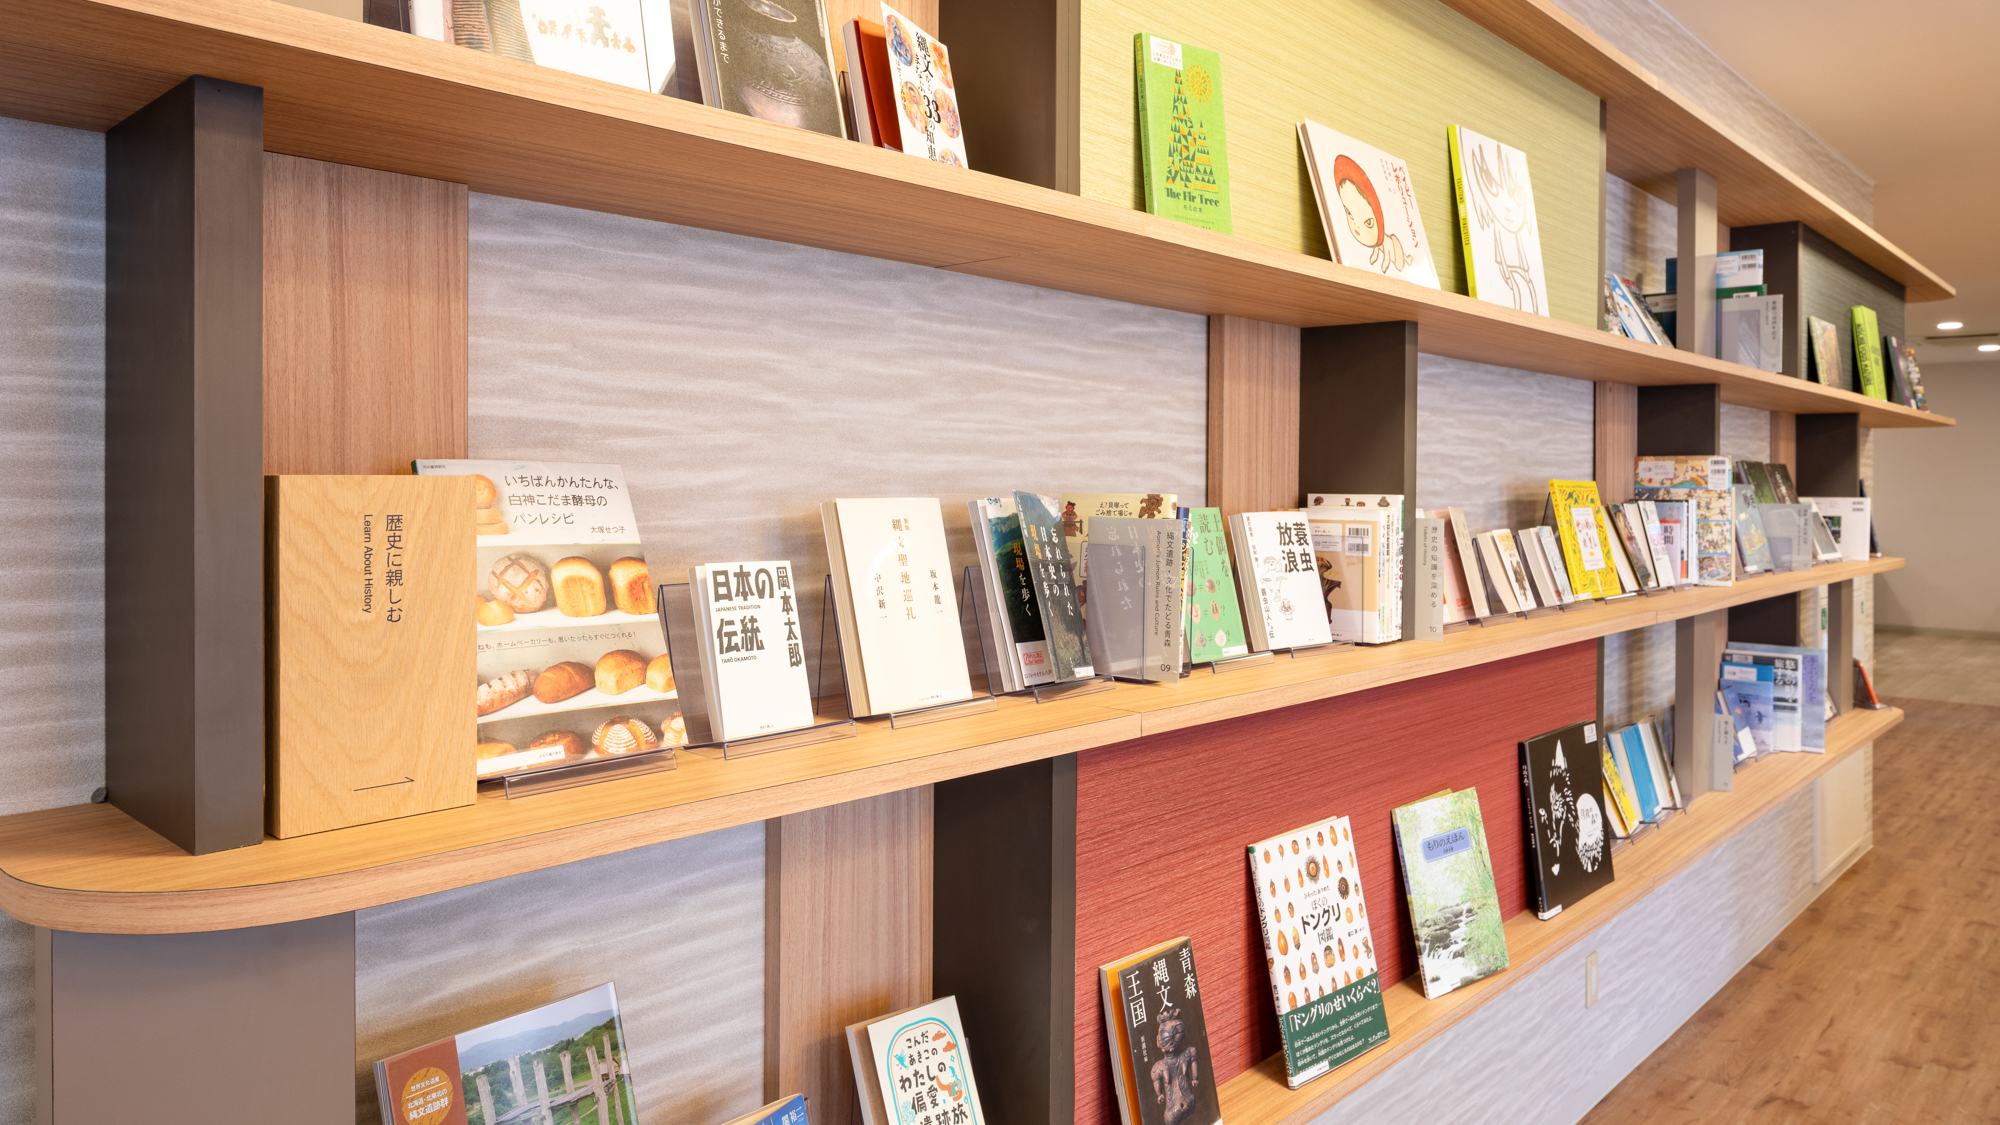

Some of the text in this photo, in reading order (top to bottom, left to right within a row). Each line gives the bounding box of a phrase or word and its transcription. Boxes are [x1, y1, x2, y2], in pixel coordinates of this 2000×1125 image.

[1164, 187, 1220, 207] The Fir Tree
[504, 475, 619, 490] いちばんかんたんな、
[508, 493, 608, 507] 白神こだま酵母の
[513, 512, 575, 525] パンレシピ
[1197, 514, 1214, 556] 読む
[1040, 526, 1060, 597] 日本史の
[1213, 513, 1230, 578] 土偶を
[1276, 521, 1300, 574] 放浪
[1292, 521, 1315, 573] 蓑虫
[362, 514, 373, 613] Learn About History
[385, 514, 403, 623] 歴史に親しむ
[1013, 542, 1032, 617] 現場を歩く
[1029, 524, 1054, 617] 現場を歩く
[1050, 527, 1074, 617] 忘れられた
[1430, 526, 1438, 608] 歴史の知識を深める
[712, 565, 775, 602] 日本の
[929, 569, 943, 614] 坂本龍一
[715, 605, 738, 613] JAPANESE
[776, 566, 803, 668] 岡本太郎
[716, 615, 766, 655] 伝統
[734, 655, 757, 663] OKAMOTO
[1160, 663, 1171, 672] 09
[1427, 831, 1466, 852] もりのえほん
[1301, 902, 1341, 935] ドングリ
[1311, 896, 1328, 910] ぼくの
[1318, 926, 1335, 945] 図鑑
[1152, 958, 1173, 1013] 縄文
[1178, 947, 1197, 1000] 青森
[1126, 970, 1147, 1028] 王国
[906, 1030, 929, 1049] こんだ
[909, 1047, 938, 1066] あきこの
[410, 1075, 440, 1092] 世界文化遺産
[899, 1062, 947, 1093] わたしの
[407, 1088, 448, 1109] 北海道・北東北の
[408, 1096, 449, 1121] 縄文遺跡群
[911, 1084, 939, 1115] 偏愛
